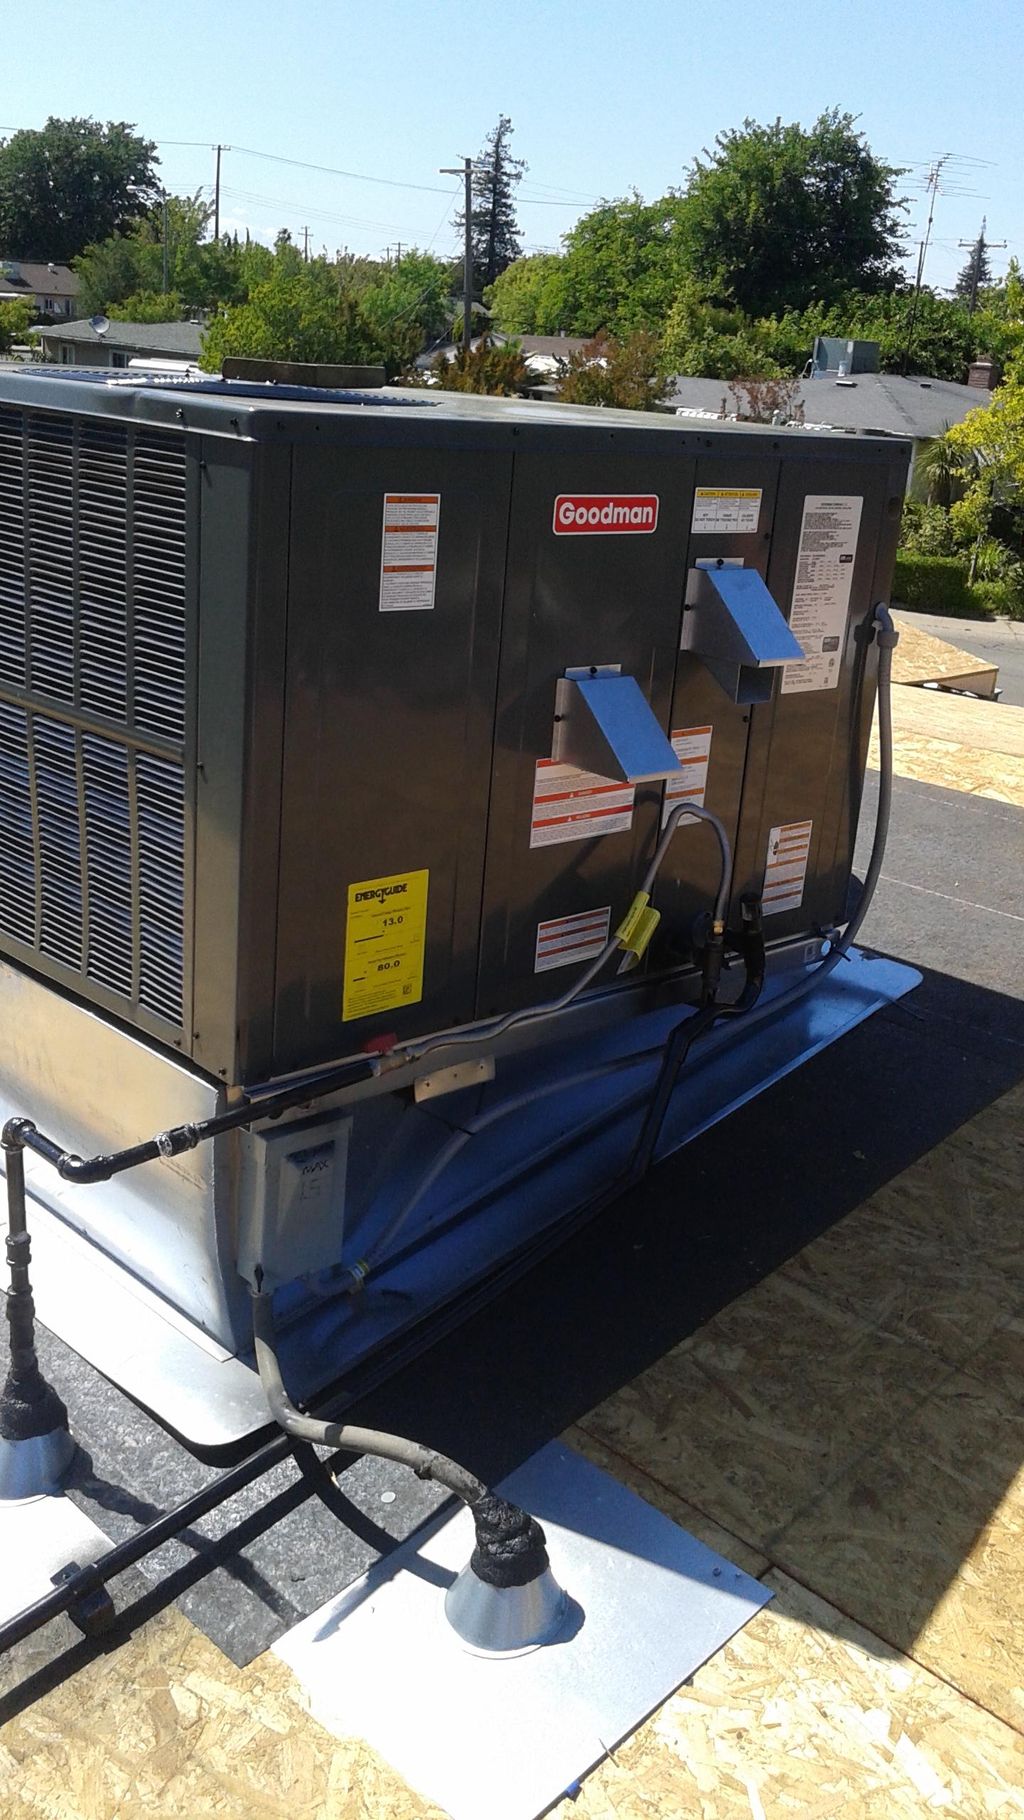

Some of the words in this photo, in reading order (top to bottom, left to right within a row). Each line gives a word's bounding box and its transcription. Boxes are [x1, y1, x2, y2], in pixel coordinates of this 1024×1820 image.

[559, 502, 653, 525] Goodman
[382, 915, 404, 927] 13.0
[377, 960, 401, 972] 80.0
